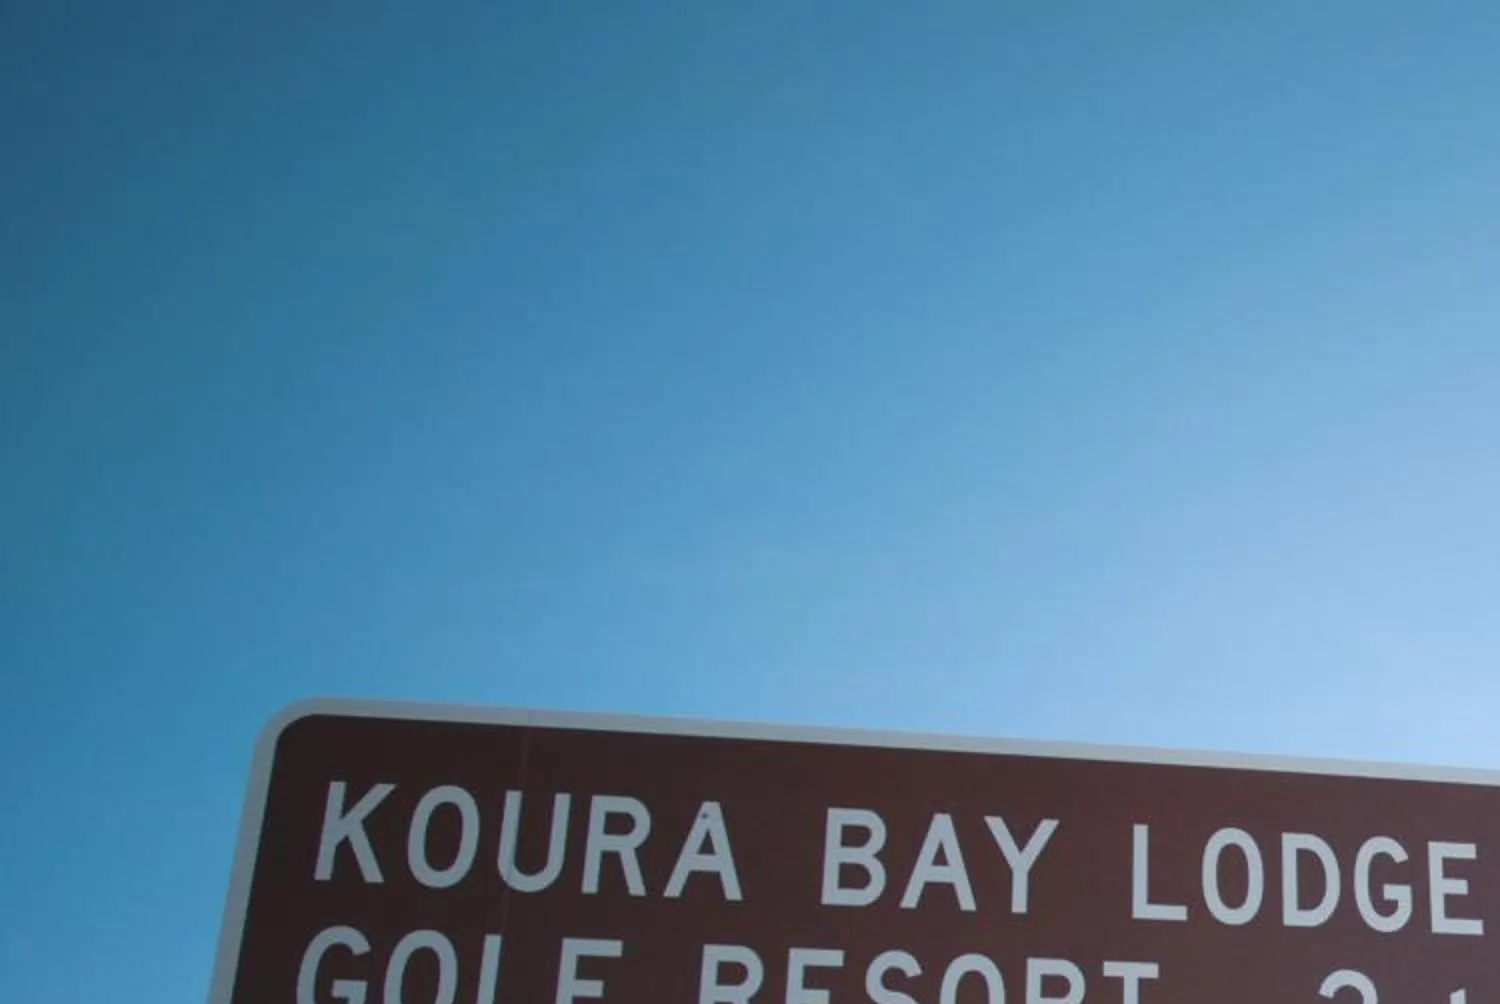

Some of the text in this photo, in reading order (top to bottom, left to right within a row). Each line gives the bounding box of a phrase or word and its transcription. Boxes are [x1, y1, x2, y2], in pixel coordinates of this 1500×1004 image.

[314, 780, 743, 902] KOURA
[821, 807, 1060, 914] BAY
[1131, 823, 1486, 937] LODGE
